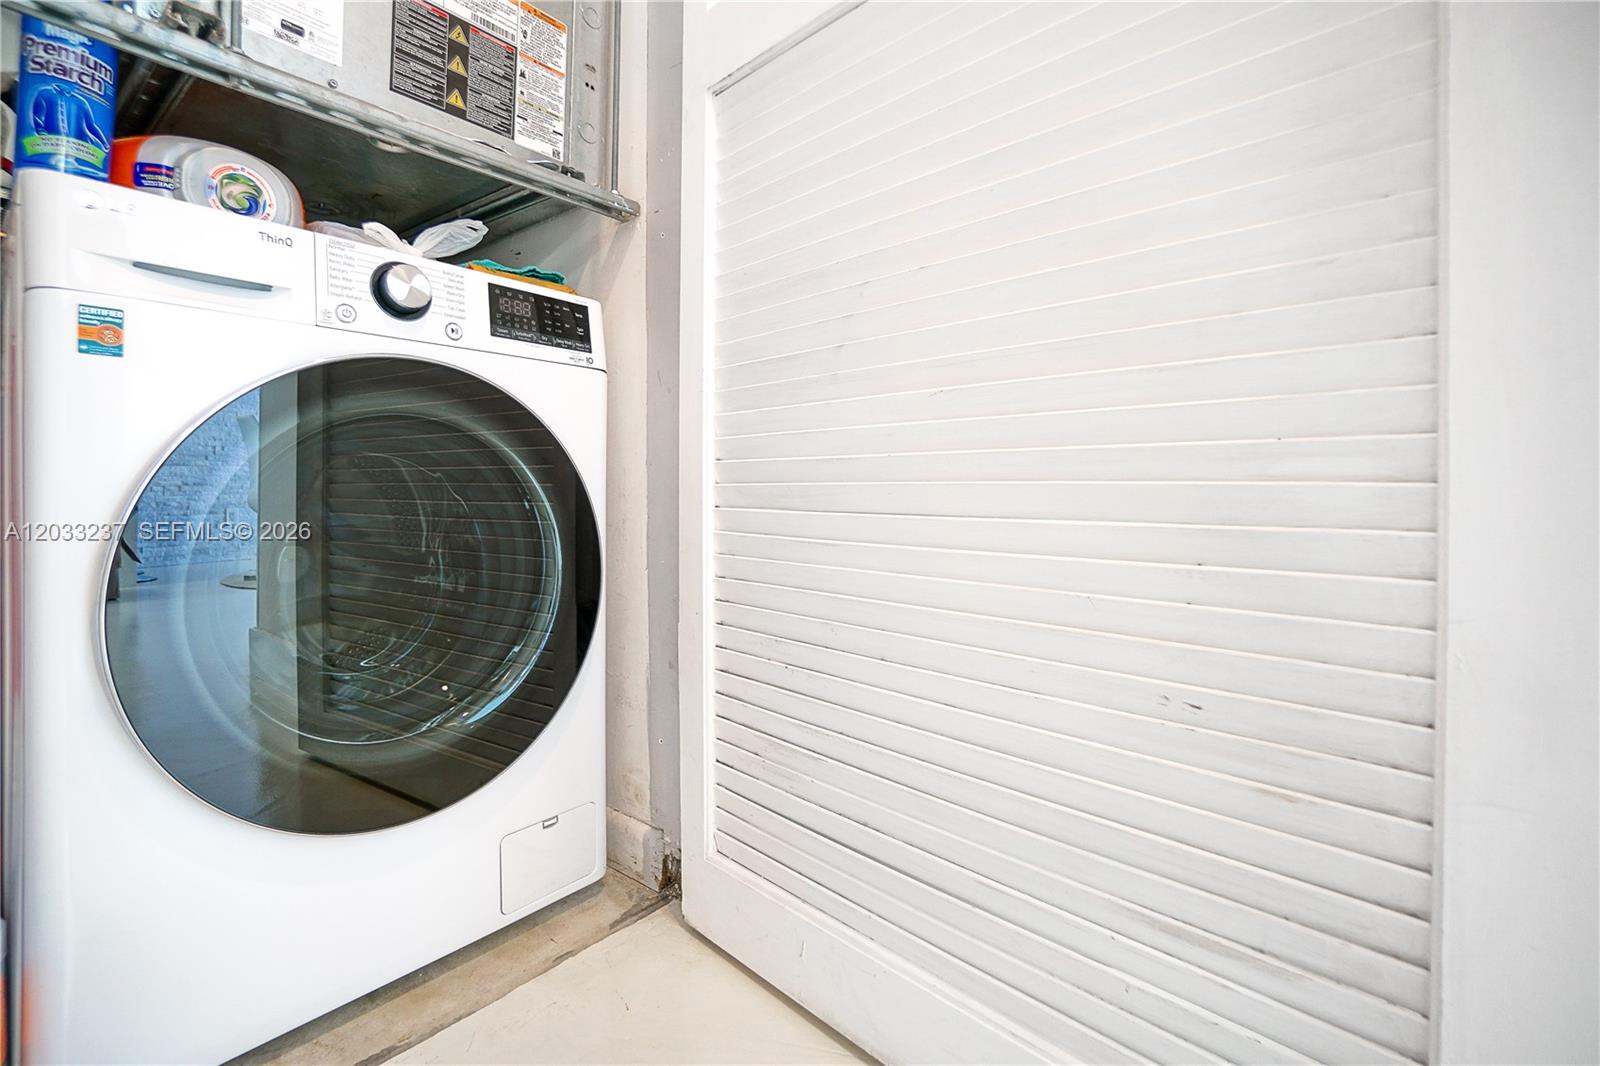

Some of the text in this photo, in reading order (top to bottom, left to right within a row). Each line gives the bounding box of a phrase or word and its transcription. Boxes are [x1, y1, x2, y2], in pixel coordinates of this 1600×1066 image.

[23, 35, 114, 84] Premium
[28, 54, 105, 95] Starch
[258, 231, 293, 248] ThinQ
[79, 305, 123, 318] CERTIFIED
